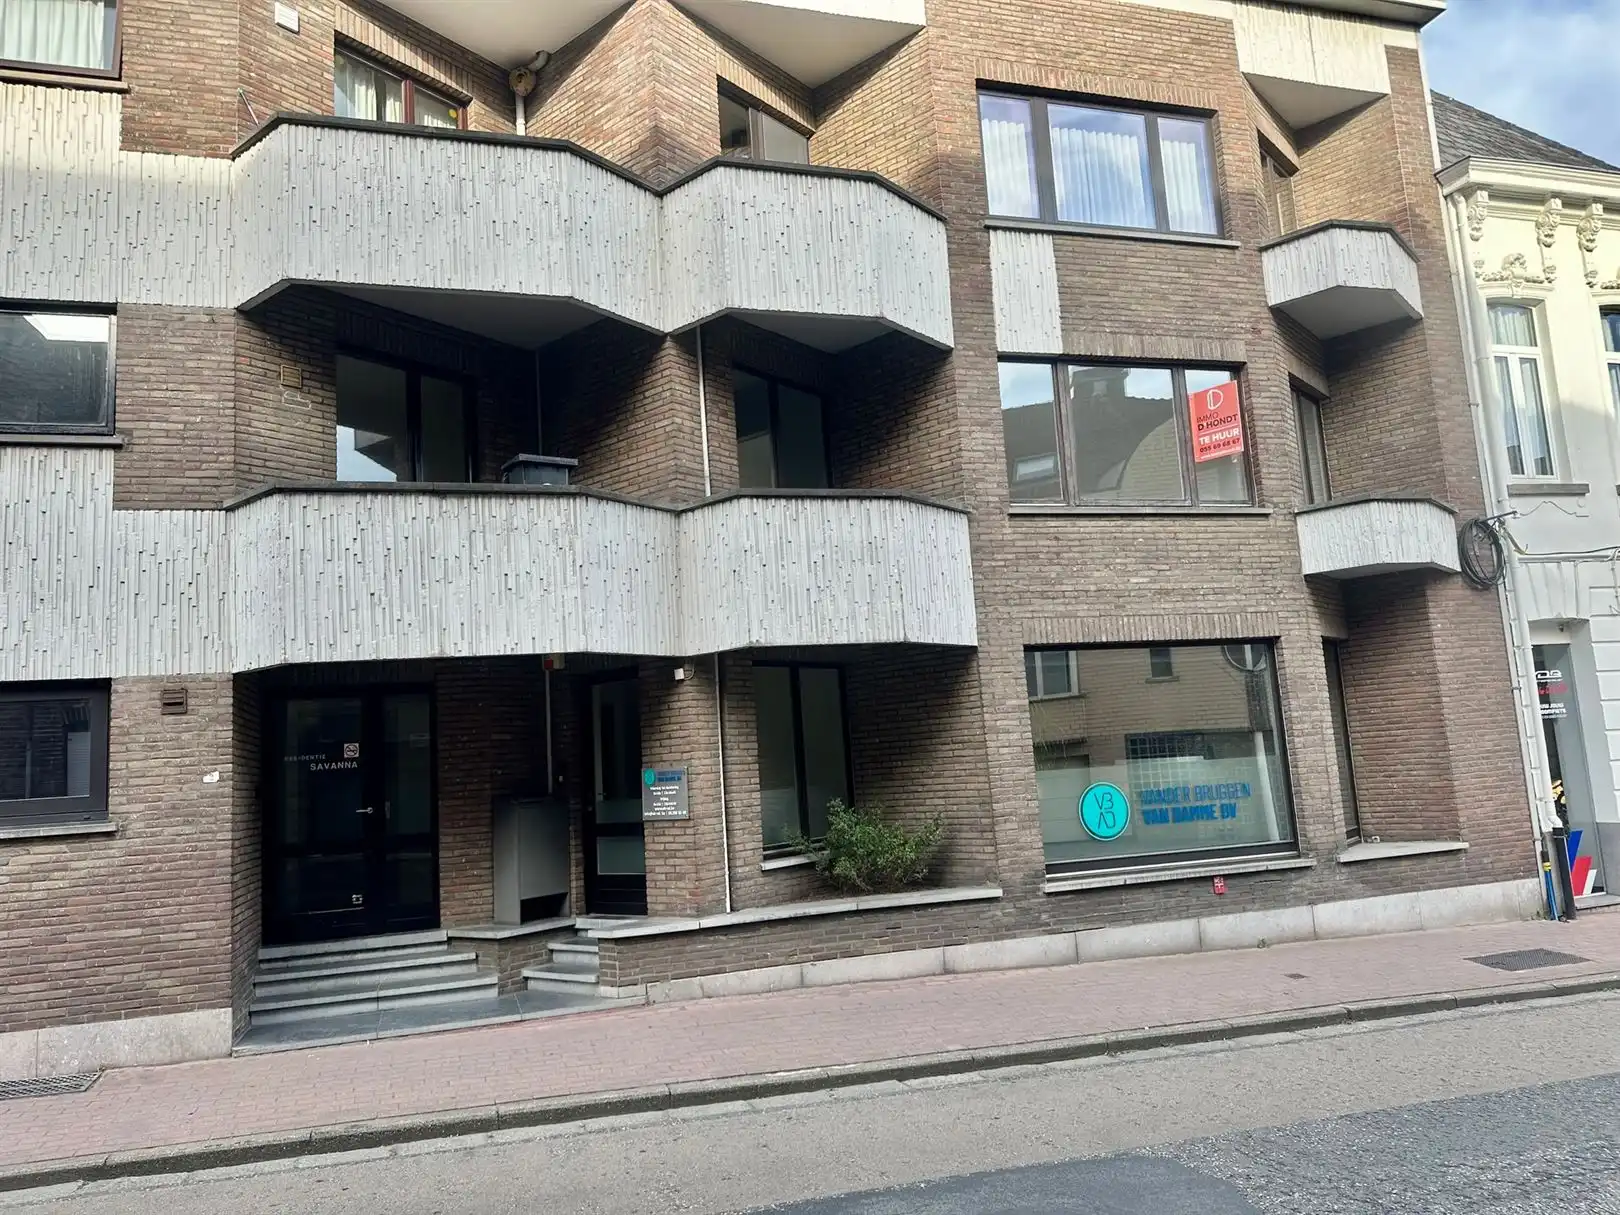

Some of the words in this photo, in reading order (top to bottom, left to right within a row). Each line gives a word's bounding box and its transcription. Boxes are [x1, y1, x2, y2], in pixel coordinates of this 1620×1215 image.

[1197, 412, 1219, 423] IMMO
[1199, 435, 1210, 446] TE
[1212, 427, 1240, 442] HUUR
[1199, 444, 1212, 453] 055
[310, 761, 358, 771] SAVANNA
[1193, 782, 1250, 802] BRUGGEN
